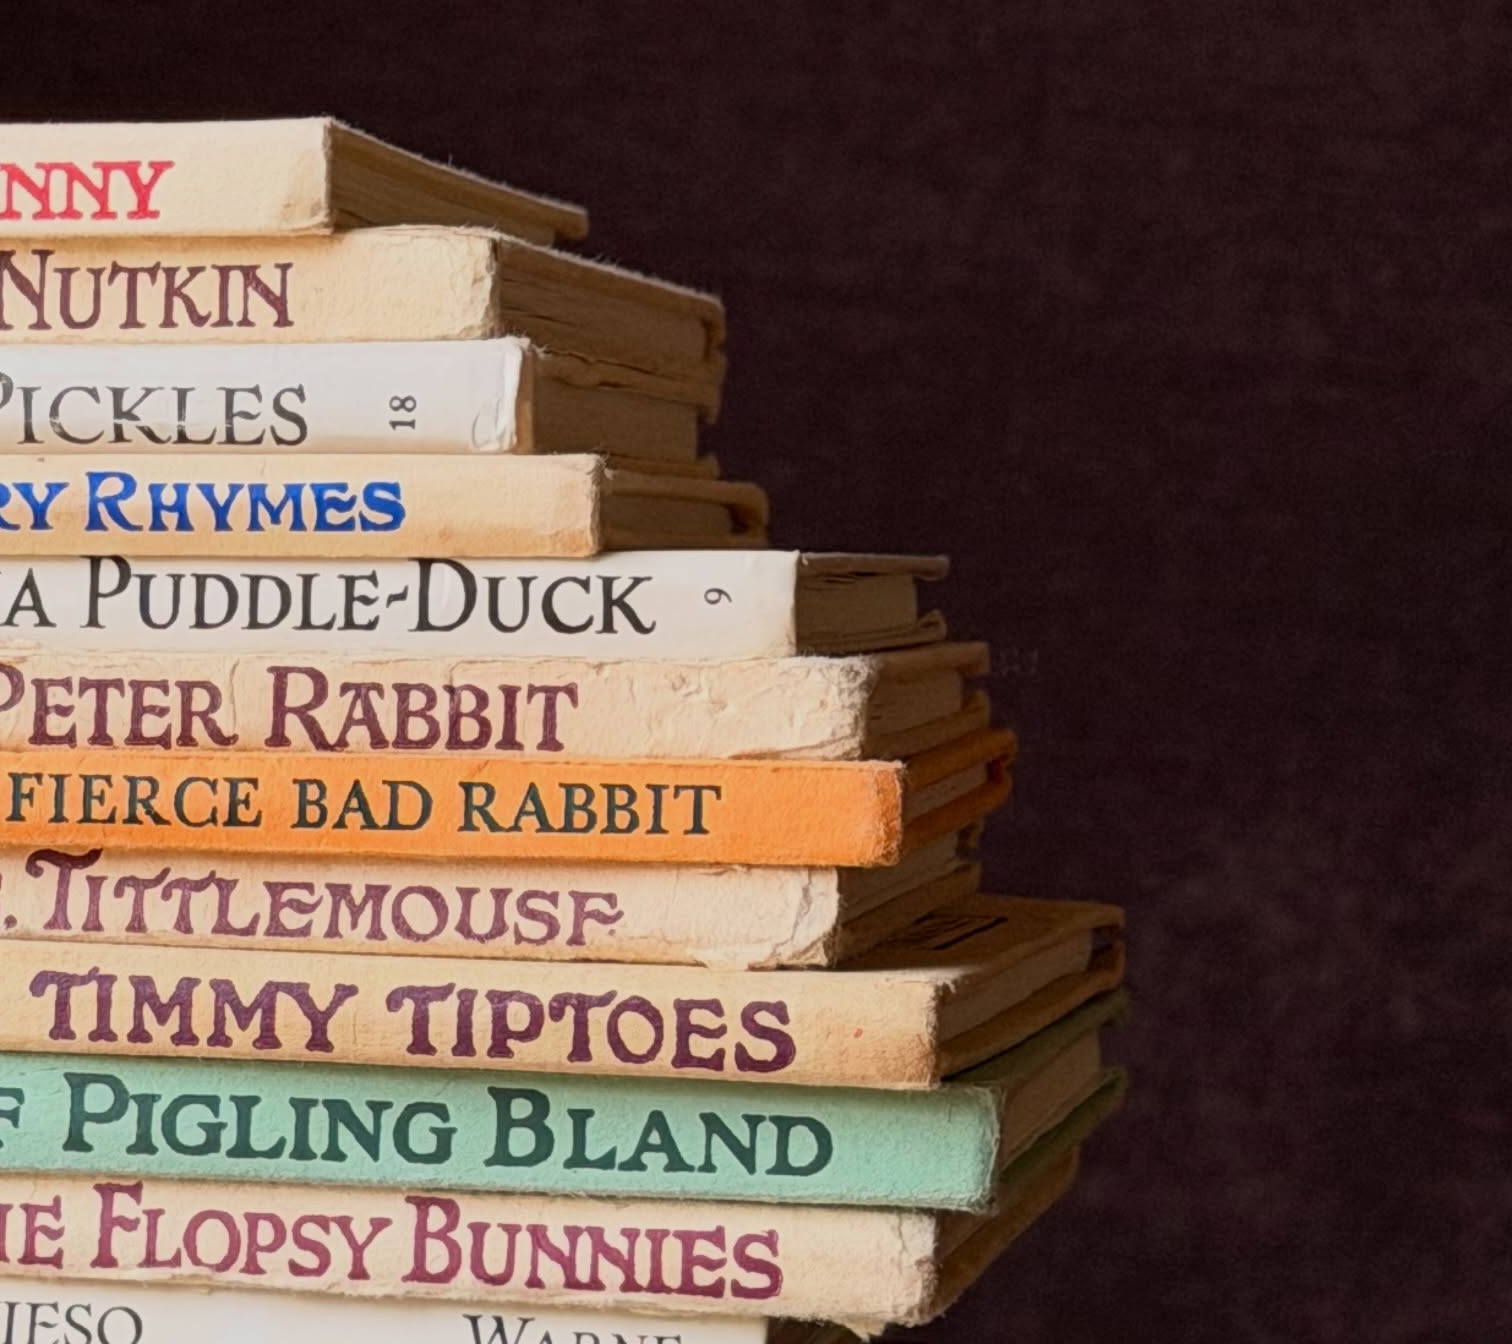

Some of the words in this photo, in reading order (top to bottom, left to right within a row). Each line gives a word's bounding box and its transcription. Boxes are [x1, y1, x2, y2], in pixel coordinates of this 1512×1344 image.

[389, 395, 417, 431] 18
[84, 472, 405, 533] RHYMES
[80, 555, 656, 635] PUDDLE-DUCK
[265, 666, 579, 752] RABBIT
[7, 774, 263, 828] FIERCE
[293, 779, 434, 832] BAD
[458, 782, 721, 835] RABBIT
[29, 966, 358, 1052] TIMMY
[386, 983, 797, 1074] TIPTOES
[62, 1072, 456, 1166] PIGLING
[483, 1086, 832, 1177] BLAND
[91, 1182, 393, 1282] FLOPSY
[402, 1195, 784, 1300] BUNNIES
